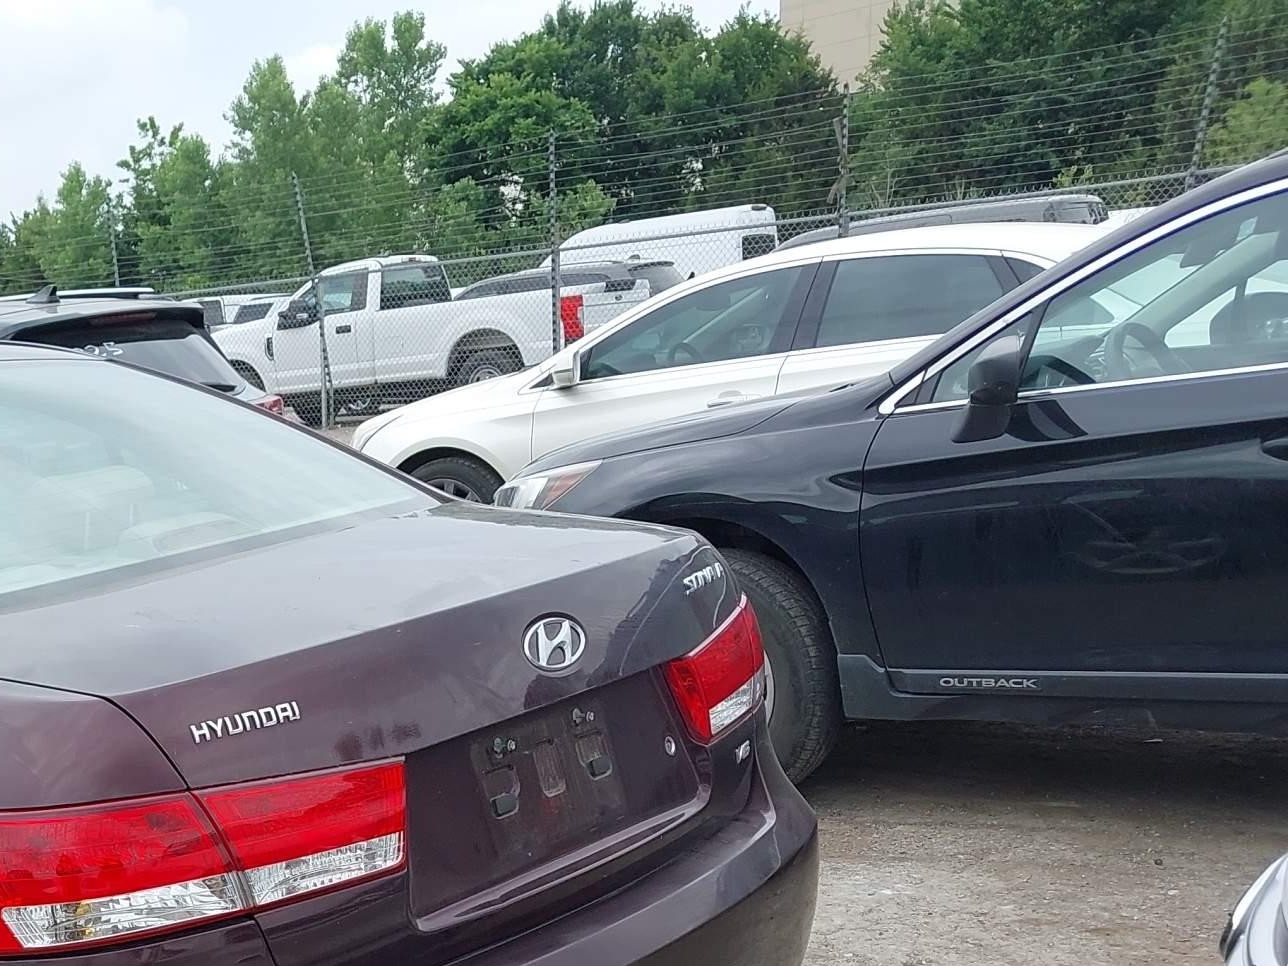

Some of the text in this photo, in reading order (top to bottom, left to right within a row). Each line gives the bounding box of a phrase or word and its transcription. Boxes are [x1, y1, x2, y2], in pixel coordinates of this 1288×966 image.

[939, 677, 1038, 689] OUTBACK
[190, 701, 300, 743] HYUNDAI
[735, 740, 750, 764] V6
